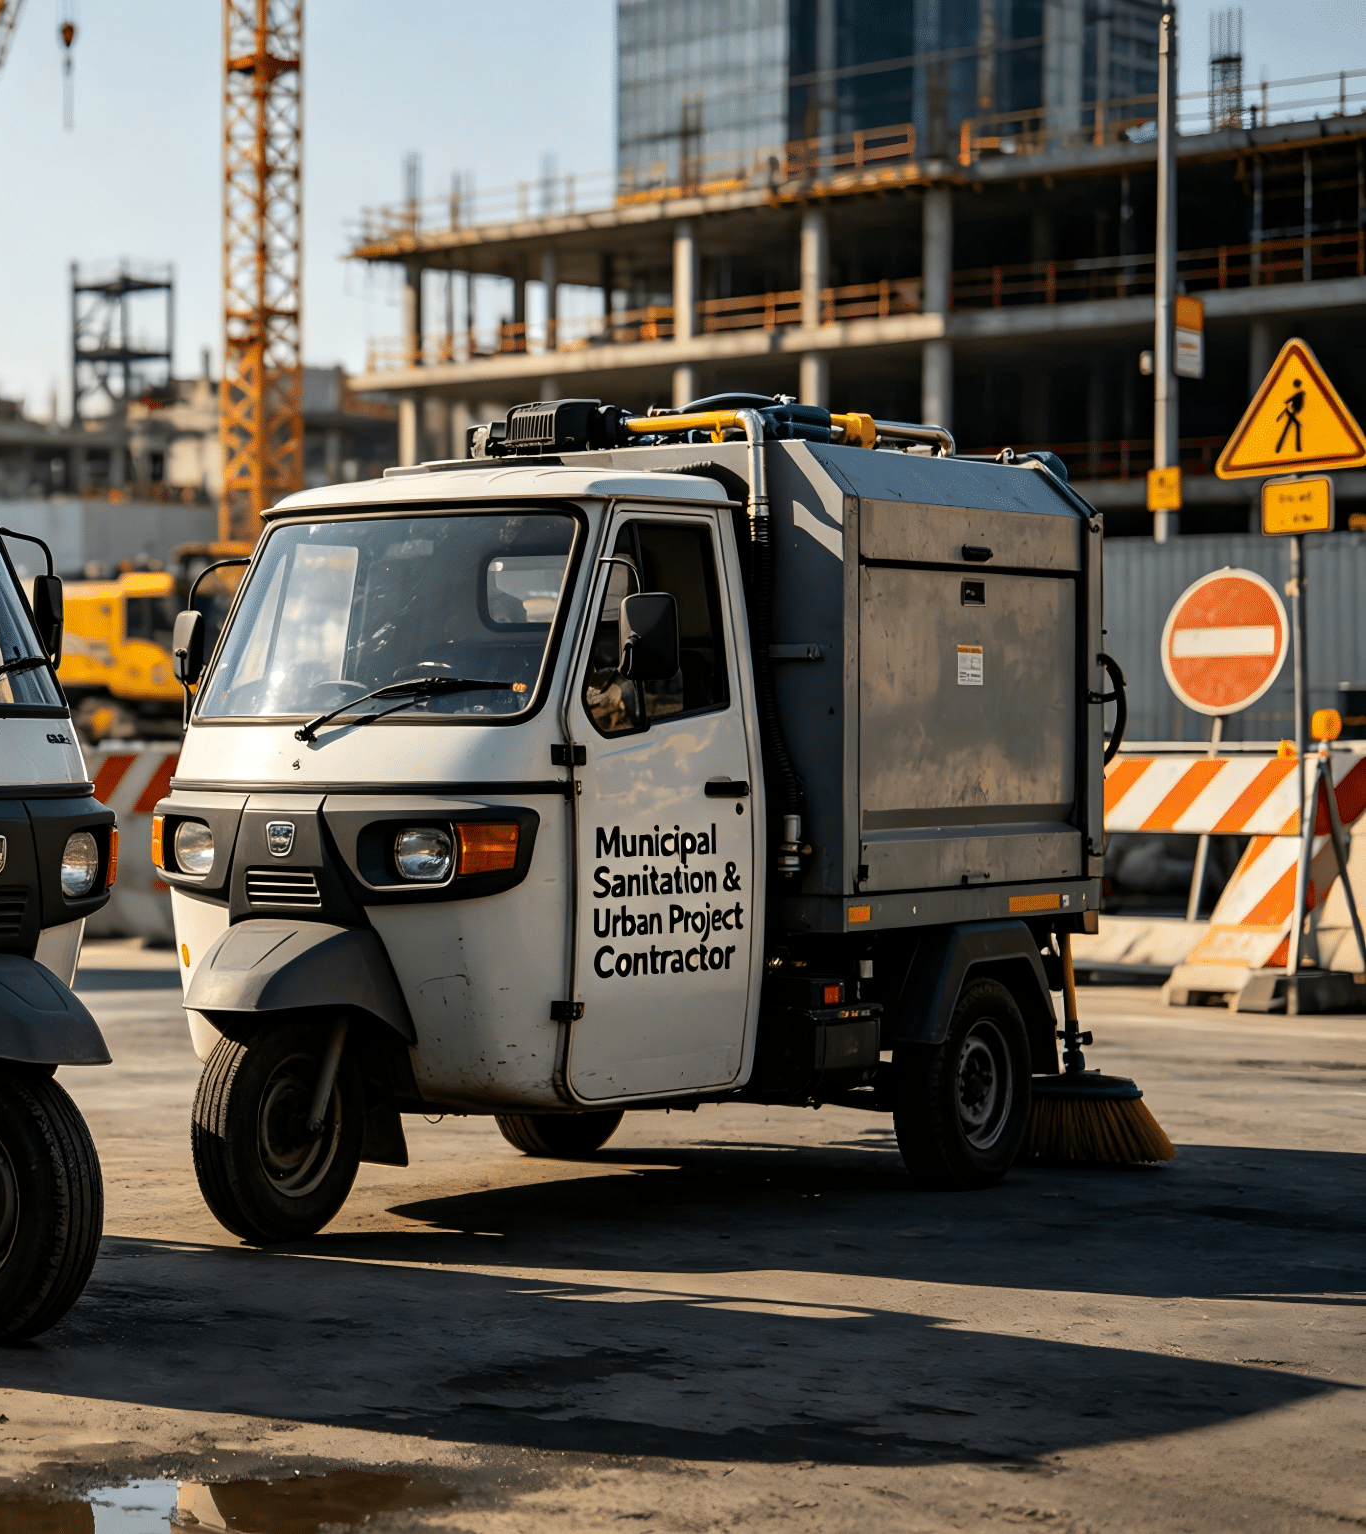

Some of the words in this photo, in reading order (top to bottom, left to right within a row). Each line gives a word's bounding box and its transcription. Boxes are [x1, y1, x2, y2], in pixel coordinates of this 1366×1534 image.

[596, 823, 716, 864] Municipal
[593, 864, 716, 898] Sanitation
[723, 861, 741, 892] &
[594, 905, 662, 938] Urban
[669, 902, 744, 942] Project
[594, 944, 736, 978] Contractor
